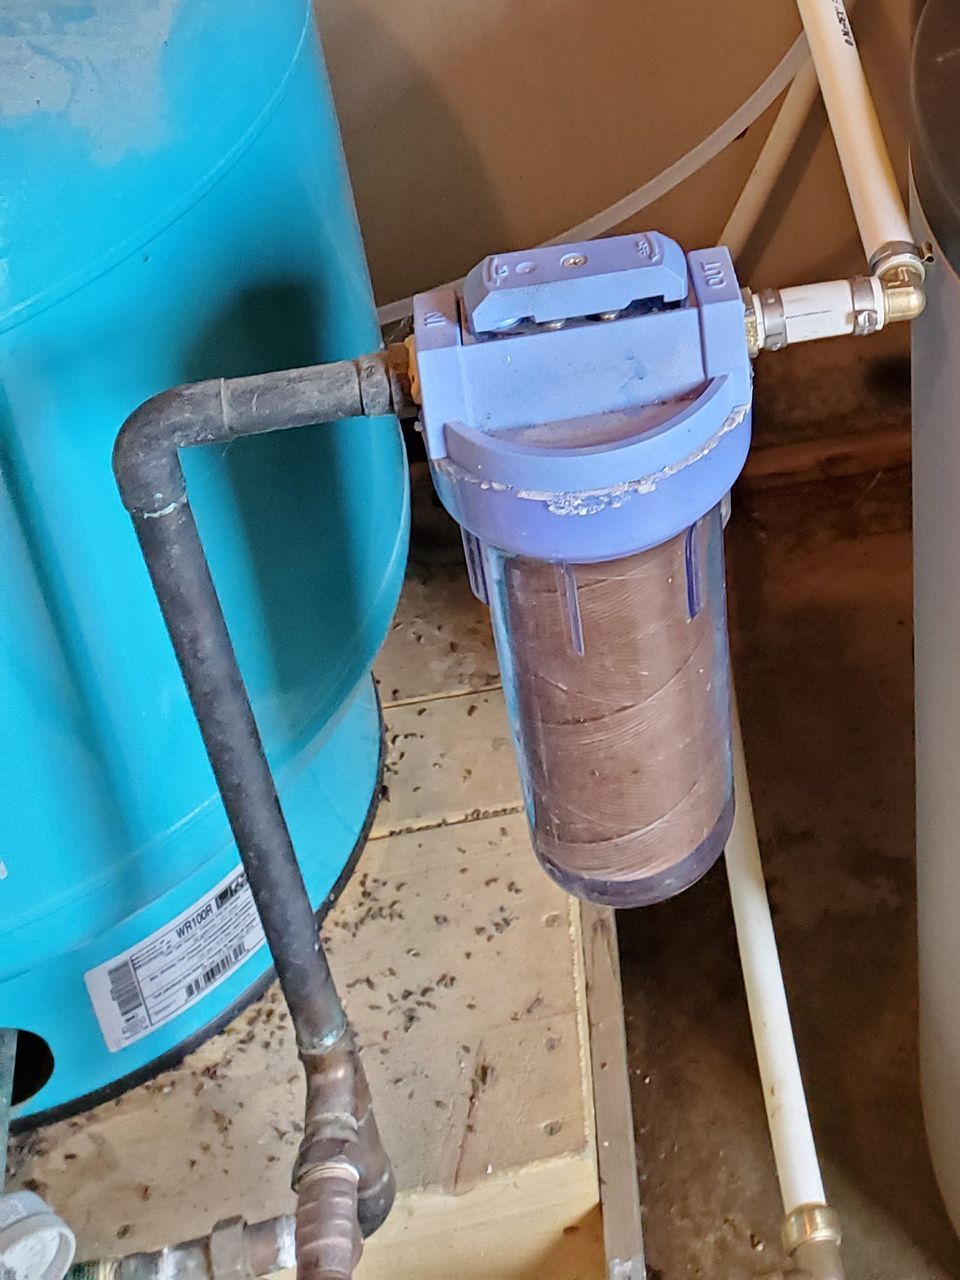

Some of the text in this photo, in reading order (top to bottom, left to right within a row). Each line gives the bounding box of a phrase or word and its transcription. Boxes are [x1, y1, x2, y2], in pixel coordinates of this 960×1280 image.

[700, 261, 727, 289] OUT
[424, 312, 446, 326] IN
[175, 903, 213, 939] WR100R
